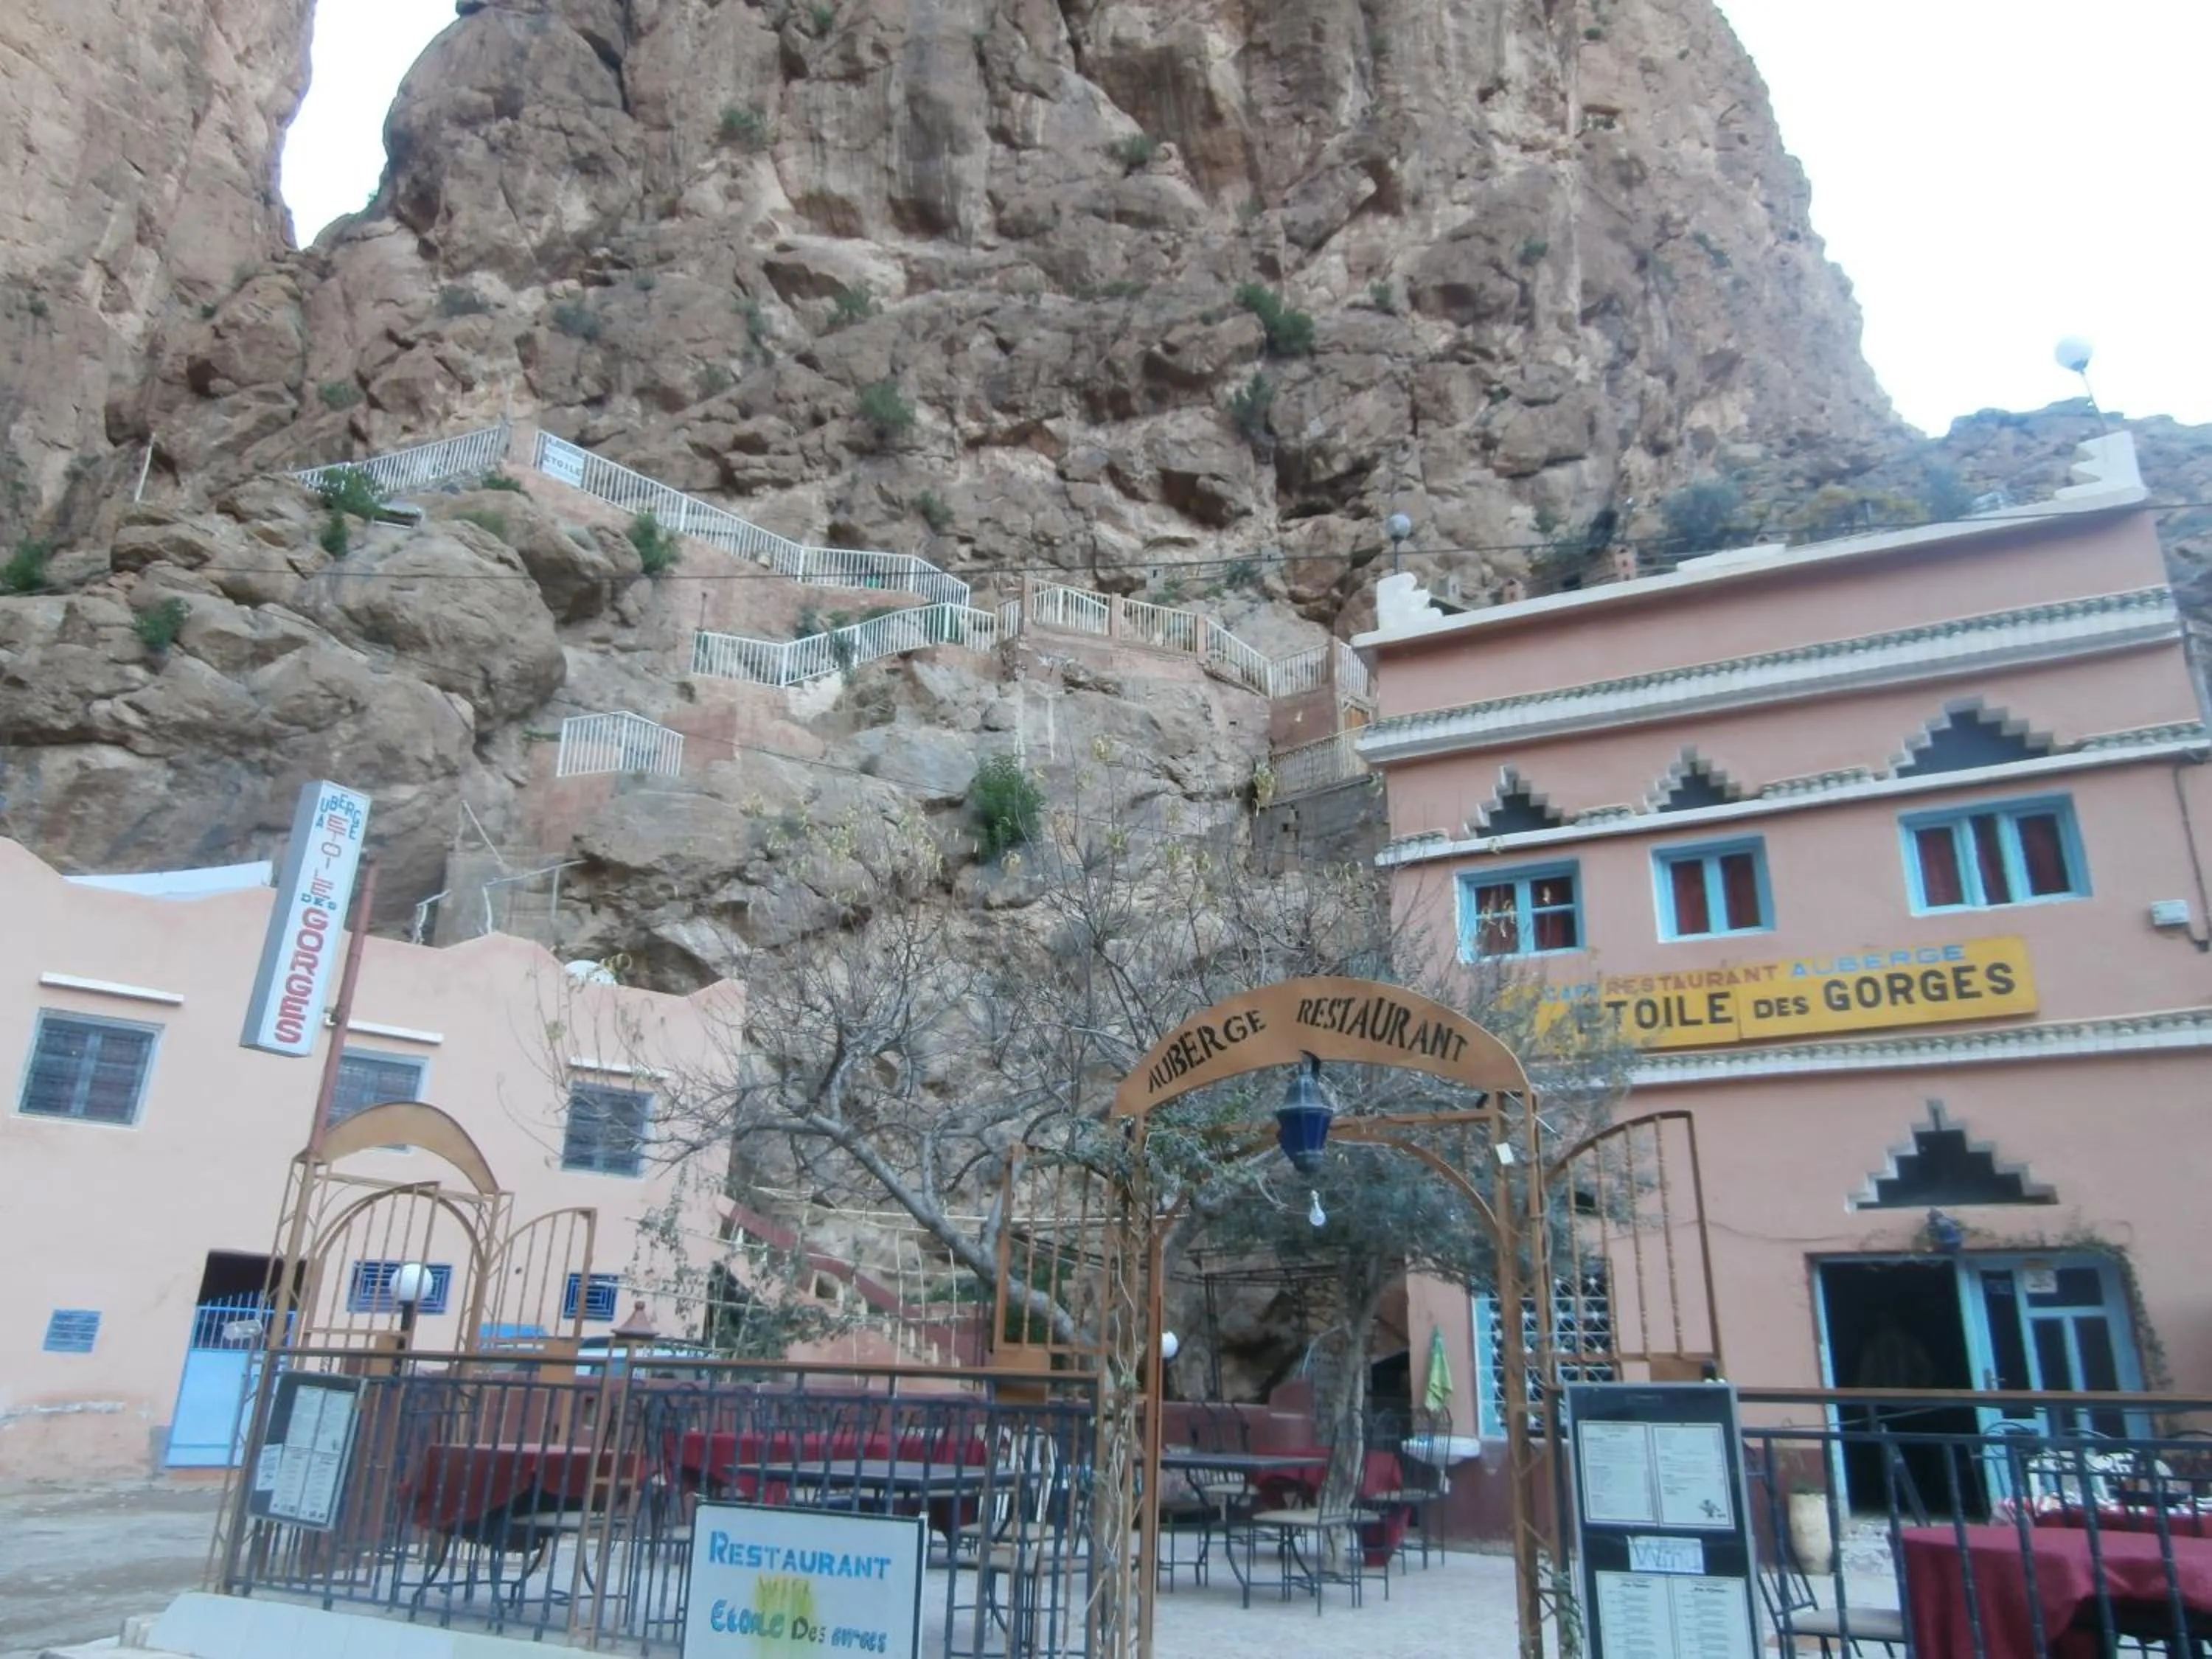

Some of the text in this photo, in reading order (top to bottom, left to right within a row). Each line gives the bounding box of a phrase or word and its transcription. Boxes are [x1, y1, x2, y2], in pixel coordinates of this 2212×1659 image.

[316, 793, 361, 840] AUBERGE
[310, 813, 349, 900] ETOILE
[300, 892, 337, 911] DES
[274, 906, 330, 1043] GORGES
[1604, 965, 1779, 995] RESTAURANT
[1791, 944, 1966, 978] AUBERGE
[1753, 995, 1809, 1020] DES
[1823, 961, 2016, 1012] GORGES
[1147, 995, 1469, 1093] AUBERGE RESTAURANT
[709, 1530, 892, 1580] RESTAURANT
